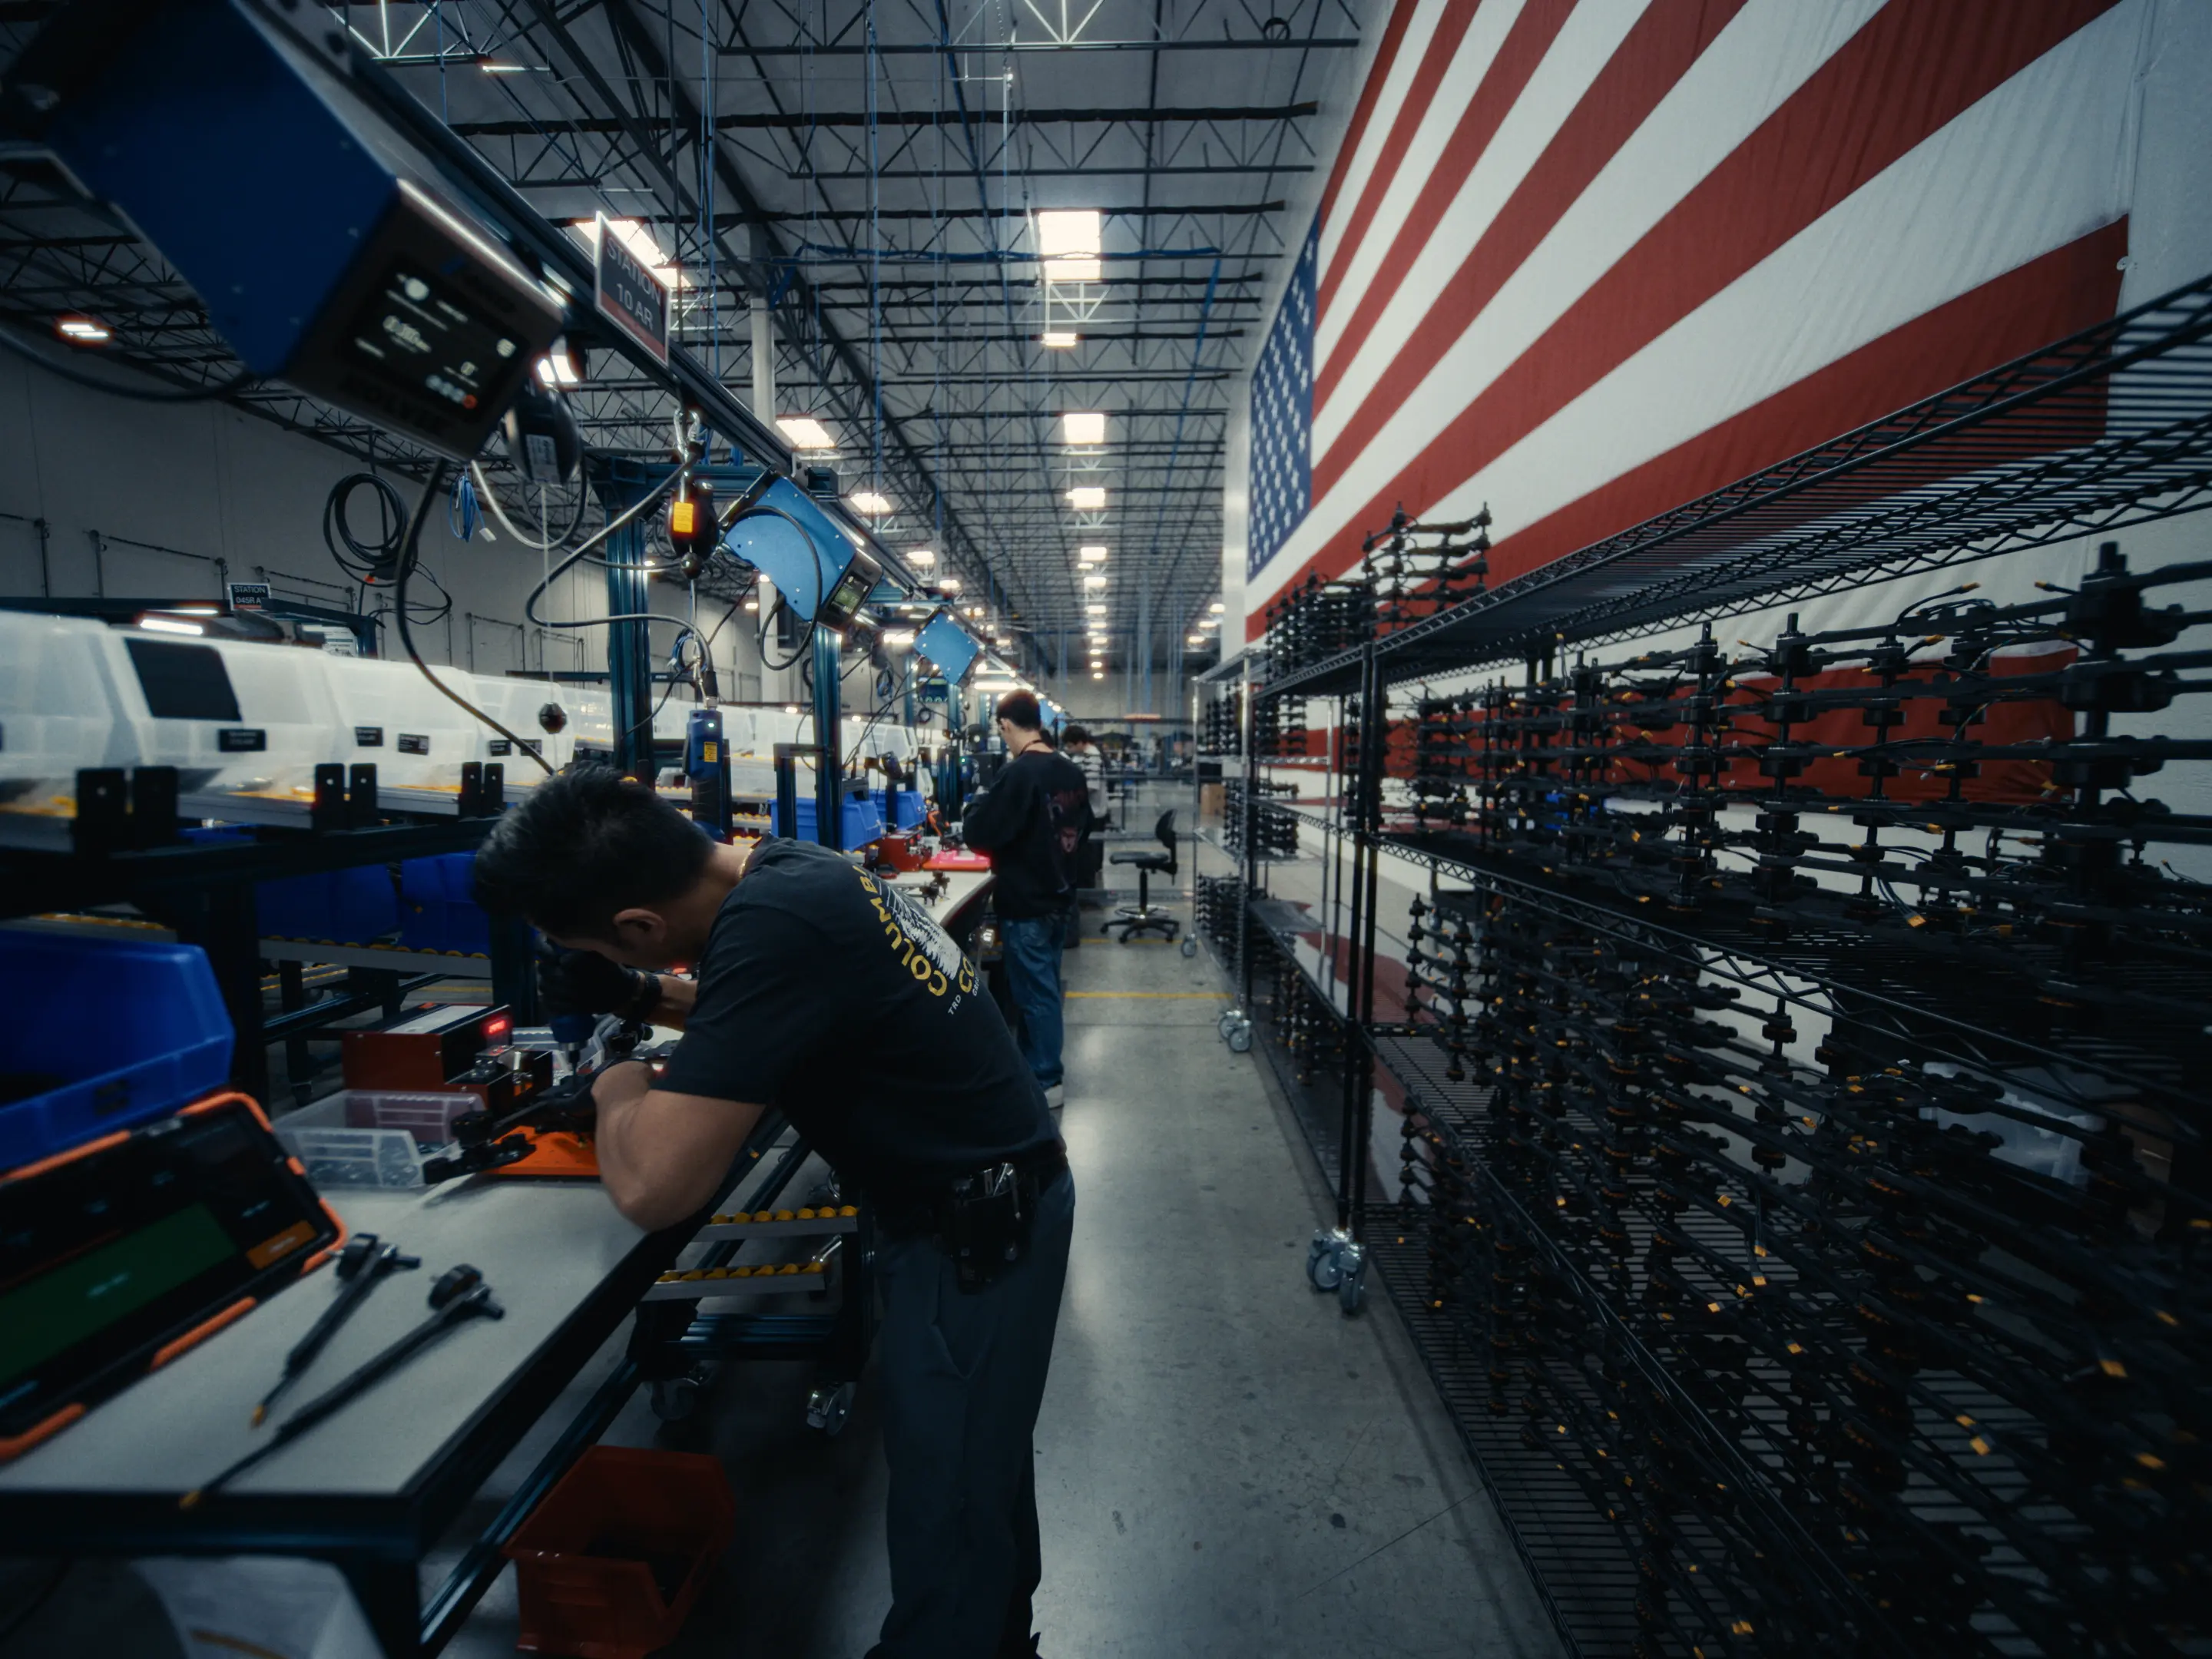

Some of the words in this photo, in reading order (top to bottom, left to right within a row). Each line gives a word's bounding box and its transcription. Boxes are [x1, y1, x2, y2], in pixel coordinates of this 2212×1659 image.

[606, 236, 662, 306] STATION
[616, 283, 634, 311] 10
[634, 300, 654, 331] AR
[233, 585, 266, 594] STATION
[947, 995, 962, 1015] TRD
